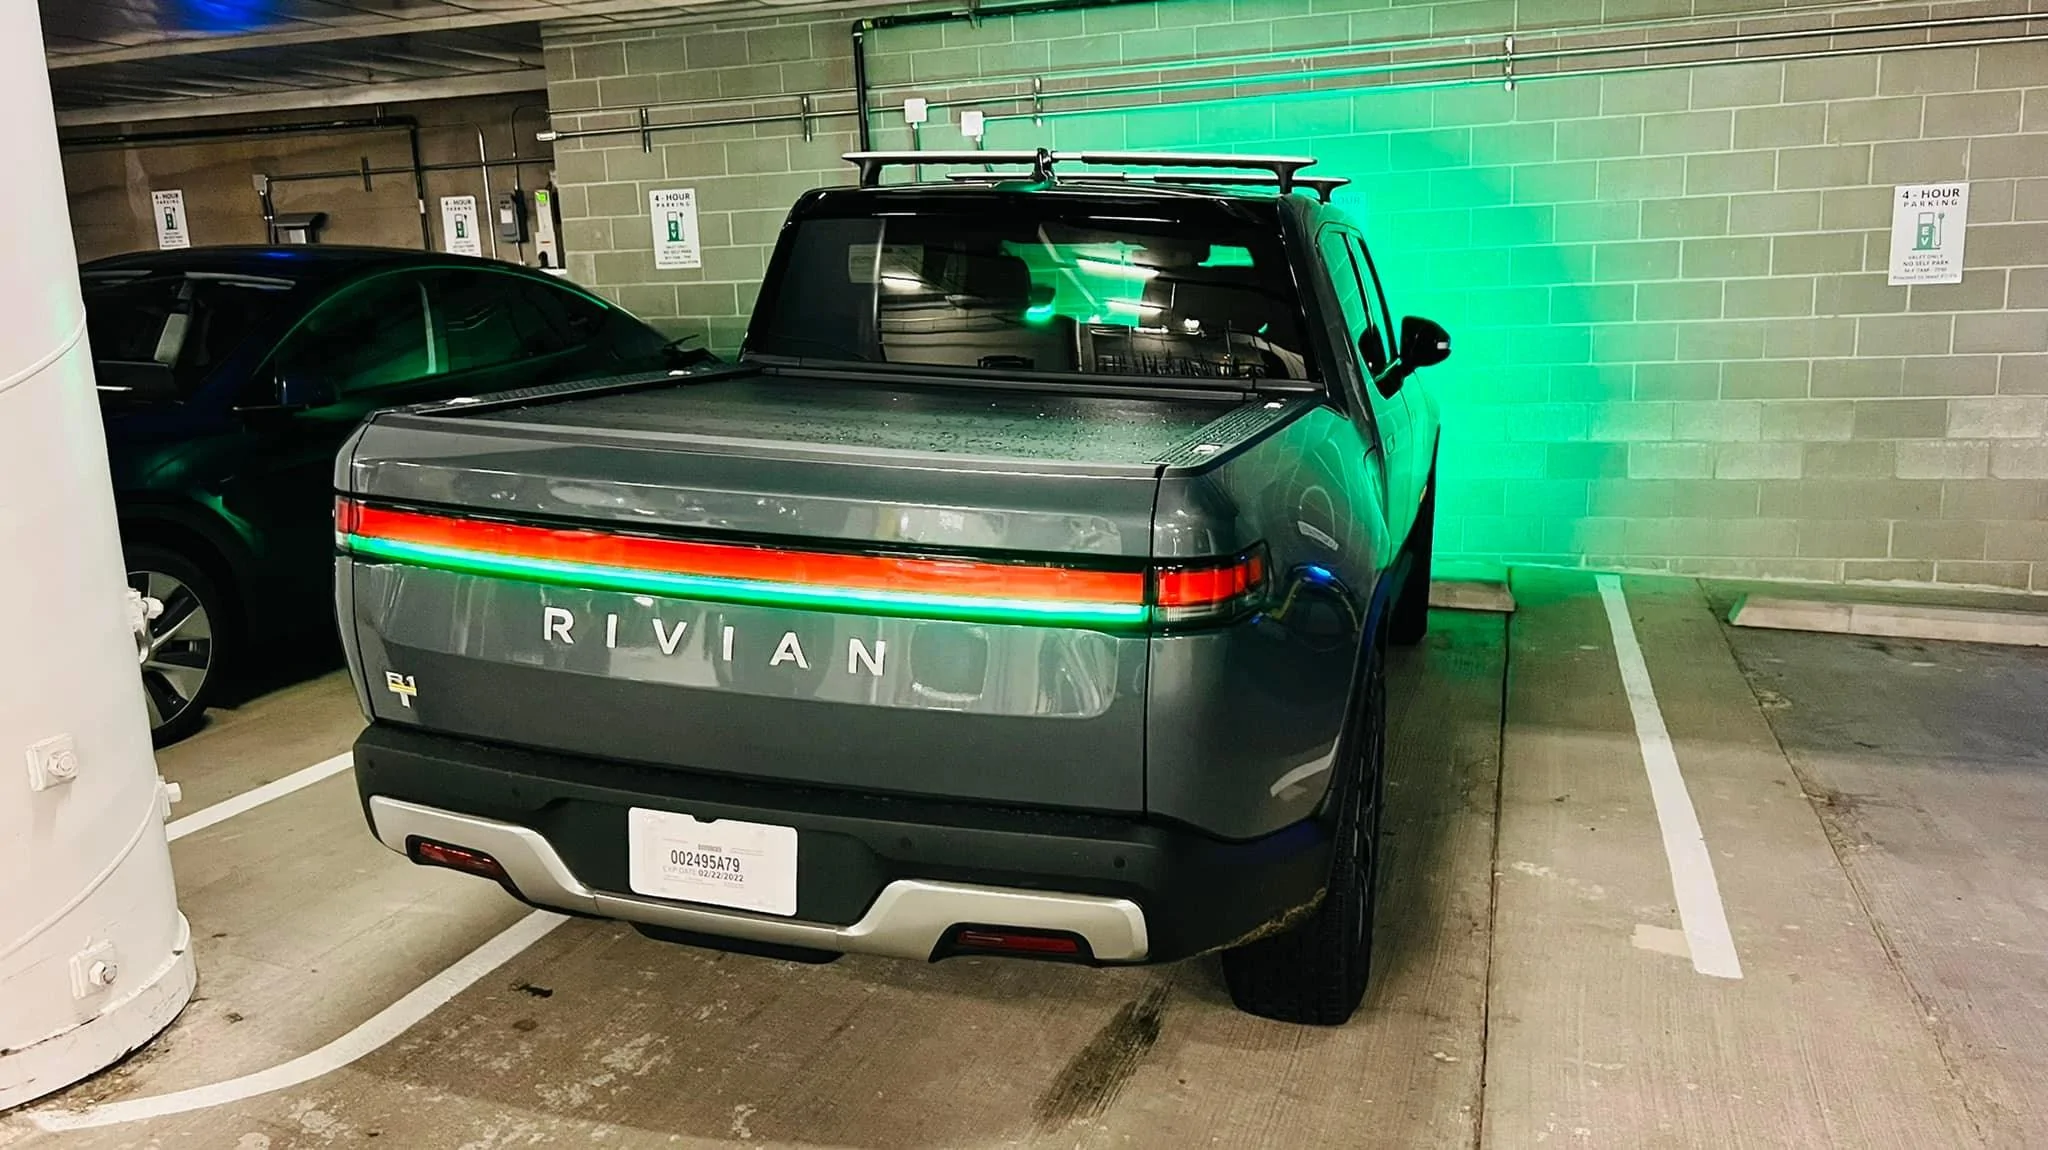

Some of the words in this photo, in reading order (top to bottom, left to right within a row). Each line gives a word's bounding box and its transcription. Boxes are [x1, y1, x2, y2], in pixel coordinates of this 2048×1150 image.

[665, 193, 690, 202] HOUR
[1902, 190, 1909, 199] 4
[1921, 188, 1960, 199] HOUR
[1903, 199, 1958, 208] PARKING
[544, 606, 887, 677] RIVIAN
[670, 849, 741, 873] 002495A79
[698, 869, 744, 882] 02/22/2022
